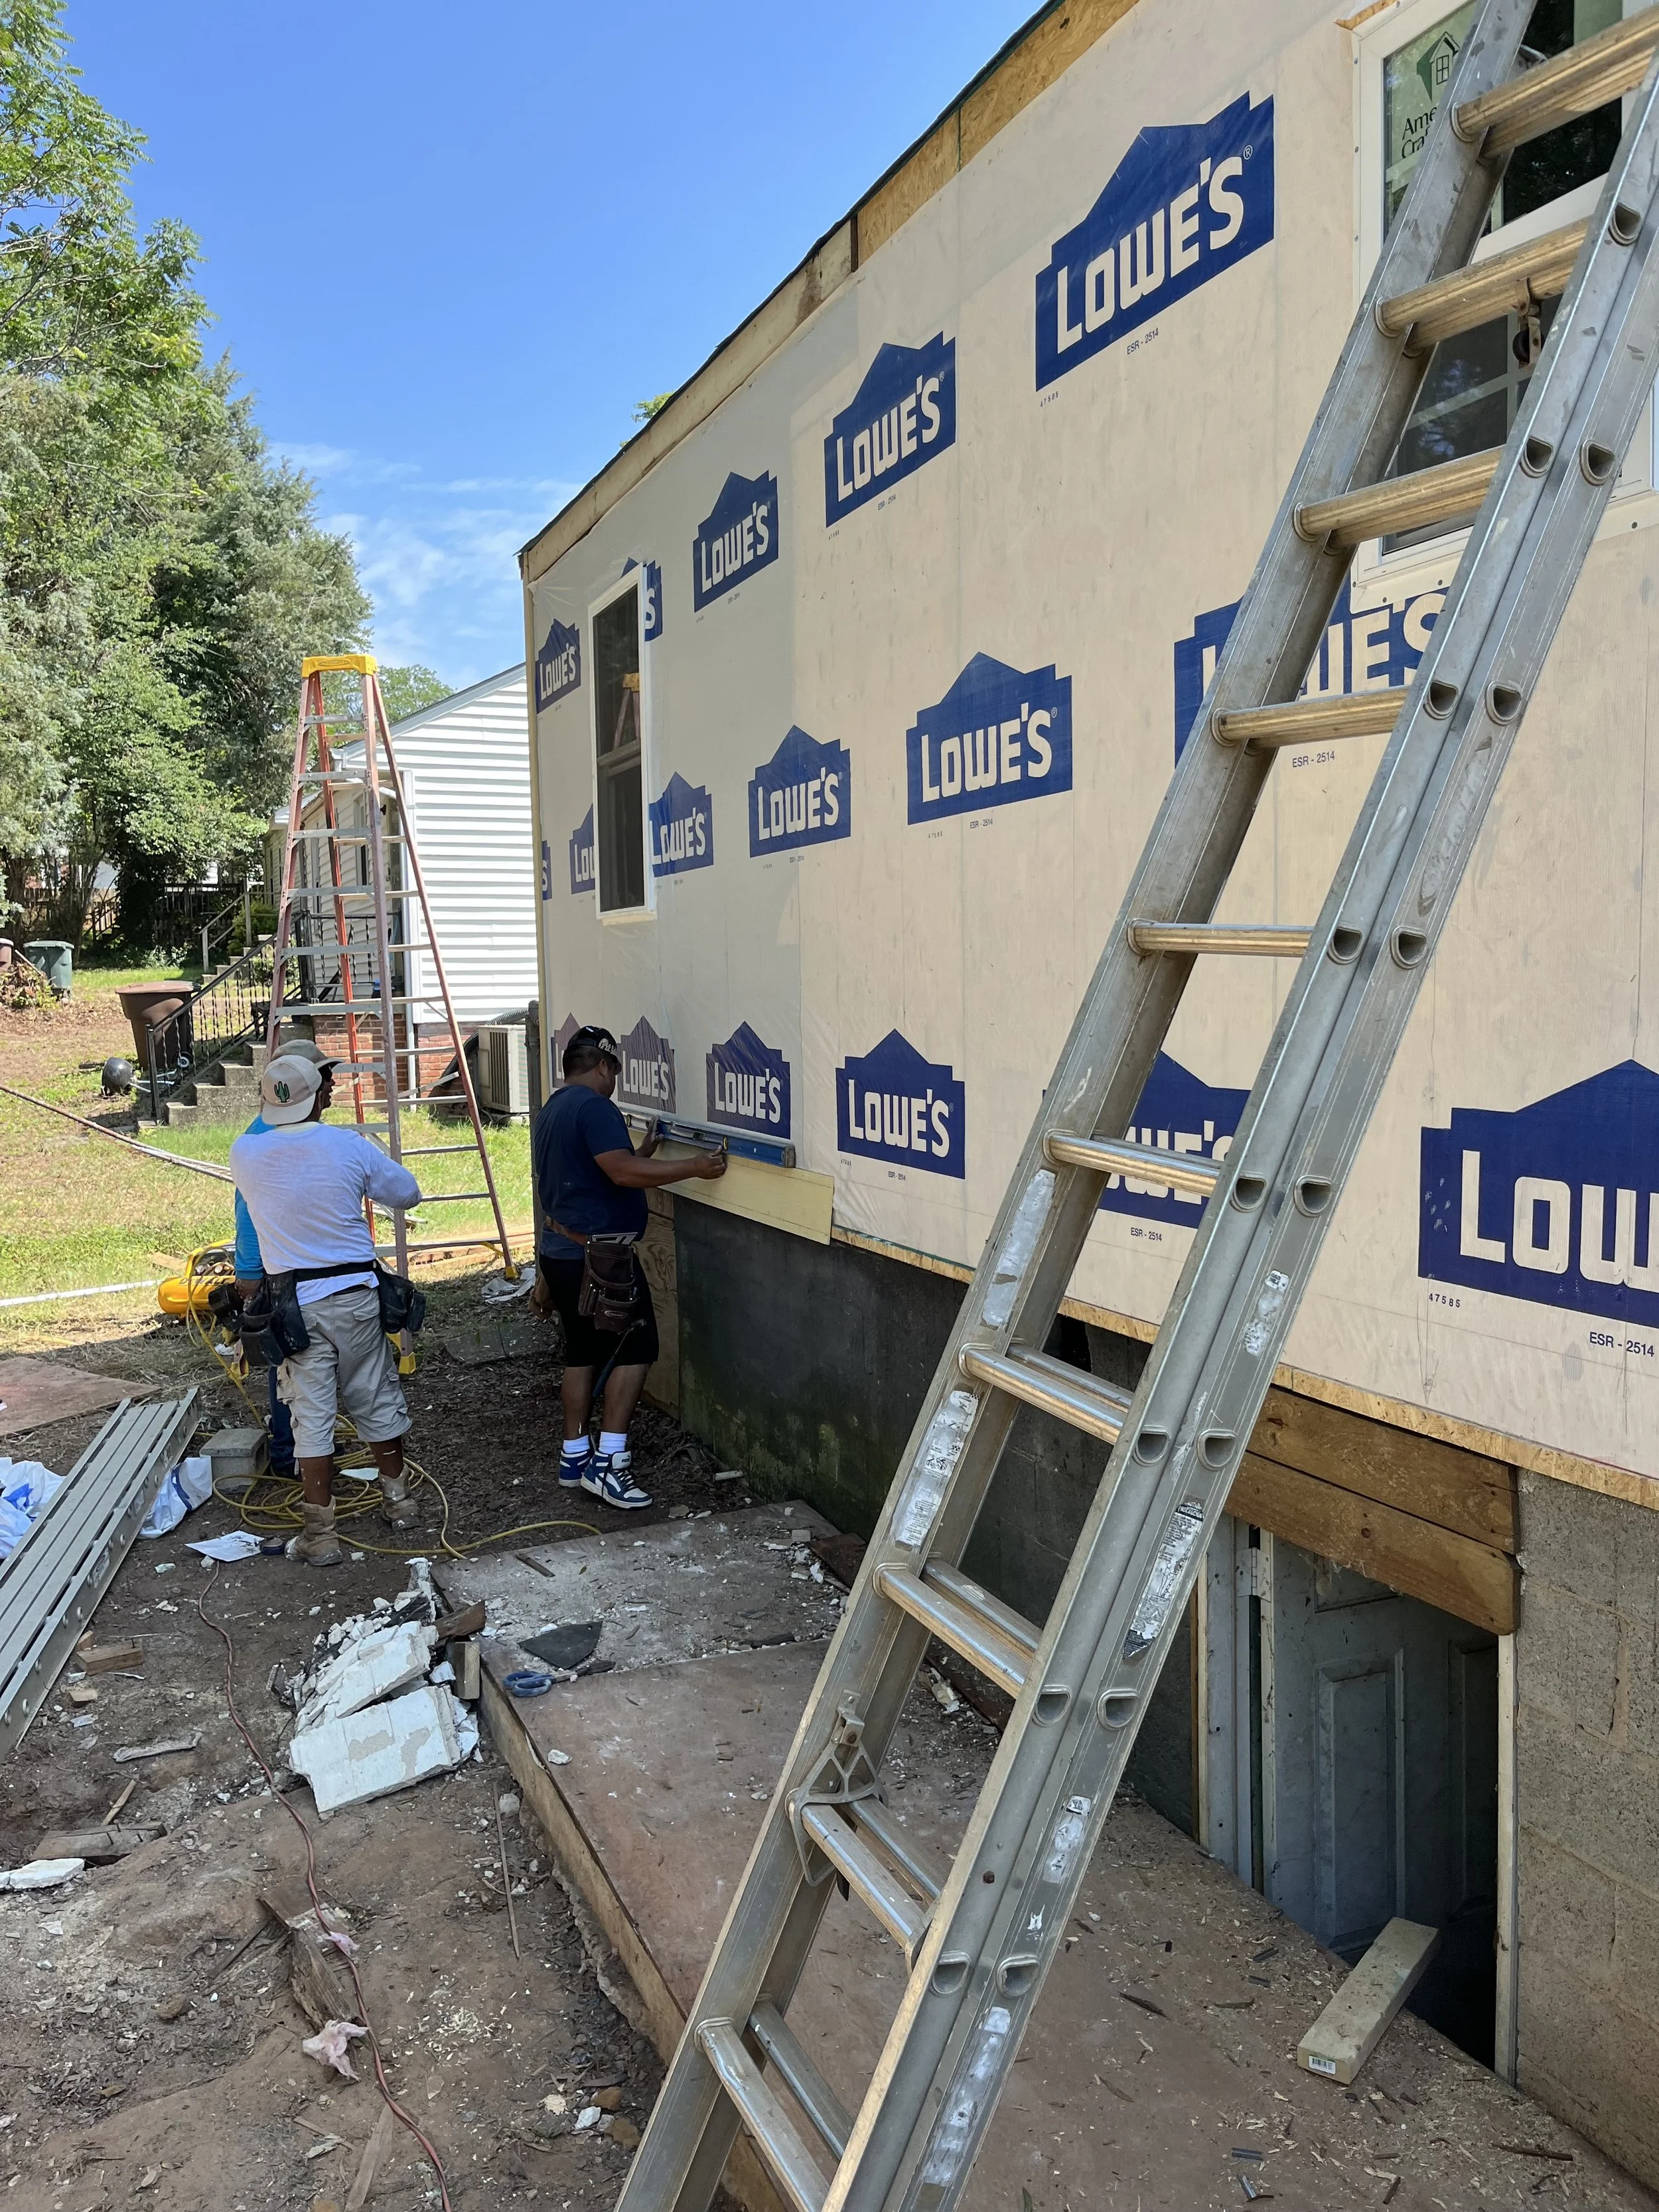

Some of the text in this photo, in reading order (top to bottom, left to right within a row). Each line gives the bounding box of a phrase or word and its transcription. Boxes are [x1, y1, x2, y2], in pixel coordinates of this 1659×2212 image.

[1056, 156, 1244, 355] LOWE'S
[1127, 339, 1139, 354] ESR
[1144, 327, 1158, 344] 2514
[836, 374, 941, 503] LOWE'S
[701, 500, 769, 593] LOWE'S
[539, 642, 576, 701] LOWE'S
[921, 701, 1052, 803] LOWE'S
[1292, 755, 1309, 767] ESR
[1317, 750, 1334, 763] 2514
[758, 767, 839, 841] LOWE'S
[970, 820, 979, 829] ESR
[982, 818, 993, 827] 2514
[649, 806, 706, 865] LOWE'S
[622, 1050, 669, 1101] LOWE'S
[714, 1062, 781, 1124] LOWE'S
[848, 1078, 950, 1158] LOWE'S
[1130, 1227, 1143, 1237] ESR
[1148, 1231, 1162, 1241] 2514
[1428, 1292, 1461, 1309] 47585
[1589, 1331, 1614, 1349] ESR
[1626, 1339, 1655, 1358] 2514
